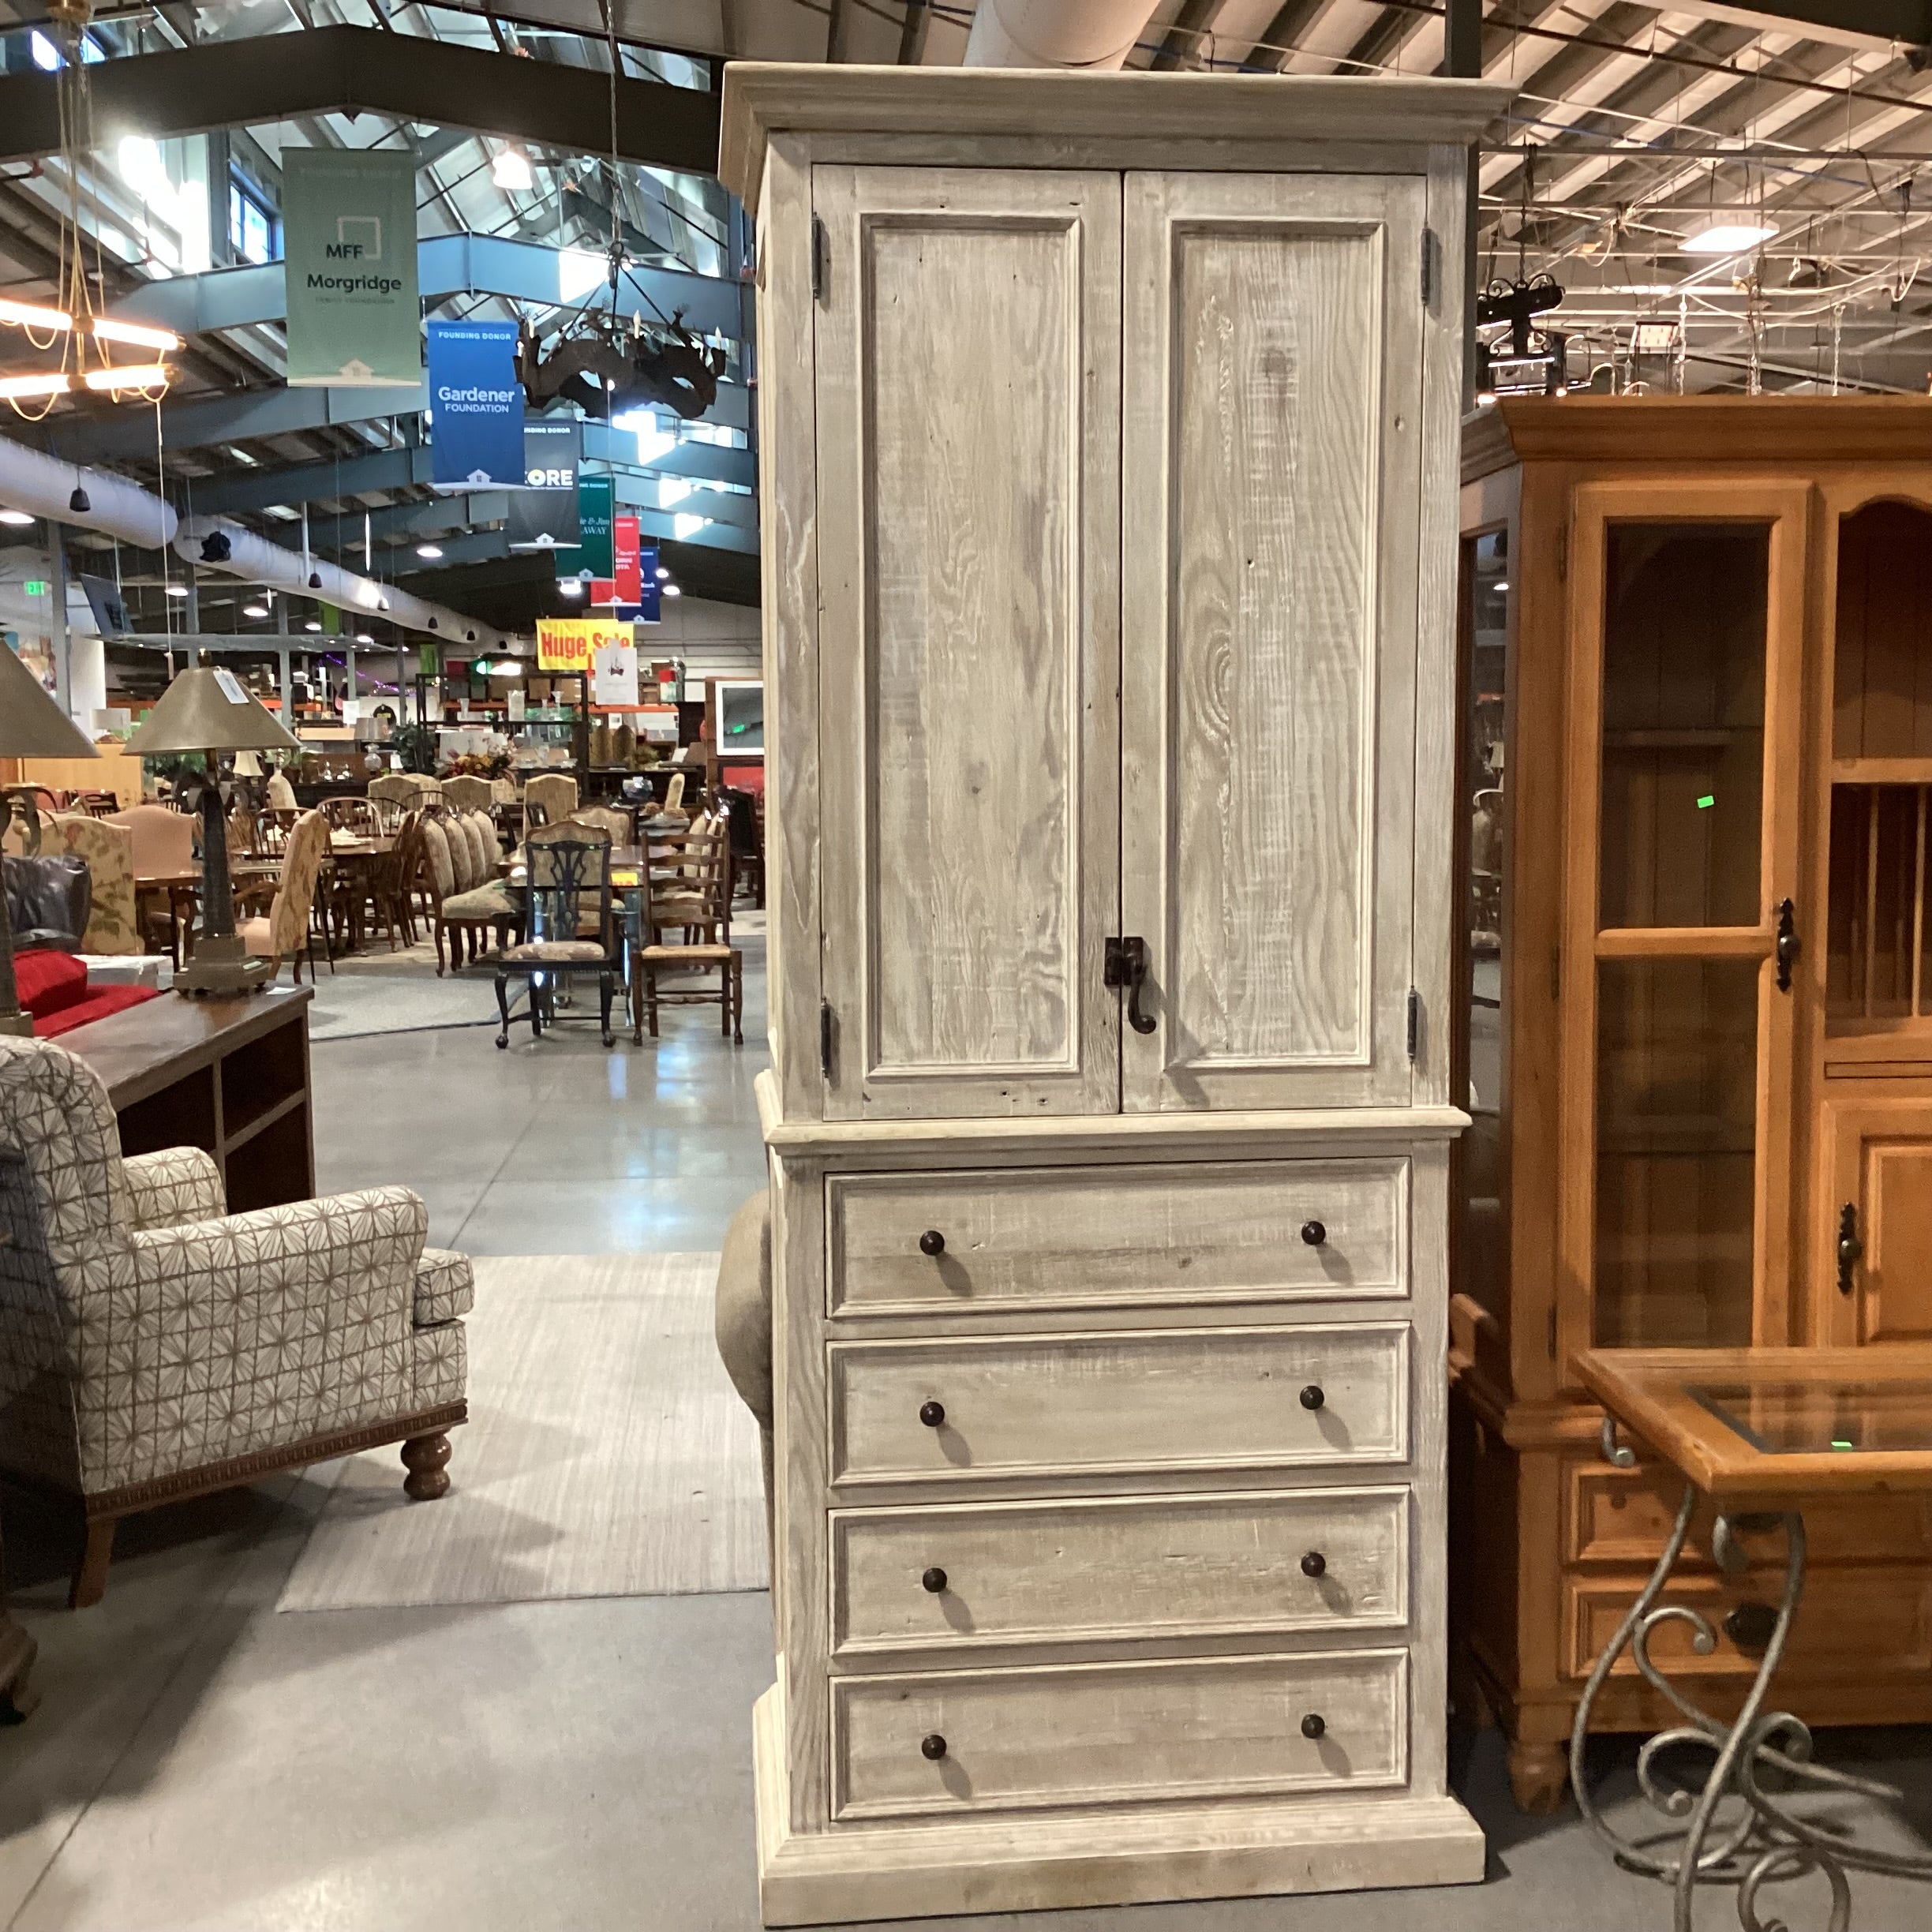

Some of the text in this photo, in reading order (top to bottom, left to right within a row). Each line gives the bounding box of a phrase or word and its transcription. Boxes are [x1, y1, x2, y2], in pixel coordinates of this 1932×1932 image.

[326, 244, 364, 259] MFF
[307, 273, 402, 294] Morgridge
[438, 386, 515, 402] Gardener
[444, 403, 509, 413] FOUNDATION
[581, 526, 606, 535] AWAY
[541, 632, 631, 659] Huge Se
